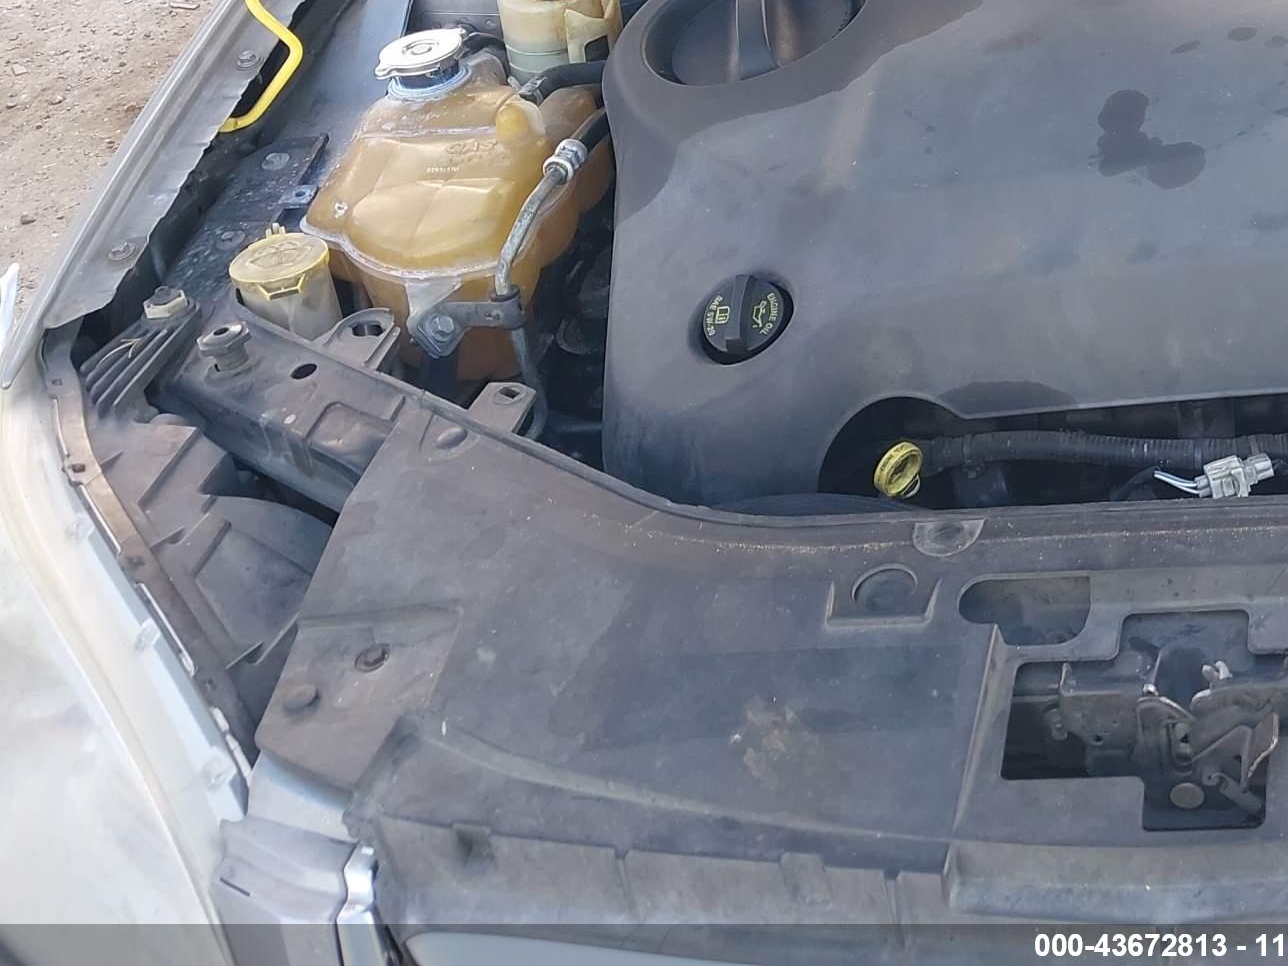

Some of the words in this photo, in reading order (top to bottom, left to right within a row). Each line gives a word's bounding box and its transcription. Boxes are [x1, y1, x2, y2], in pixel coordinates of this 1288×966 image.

[709, 295, 723, 310] SAE
[767, 293, 778, 321] ENGINE
[760, 323, 773, 335] OIL
